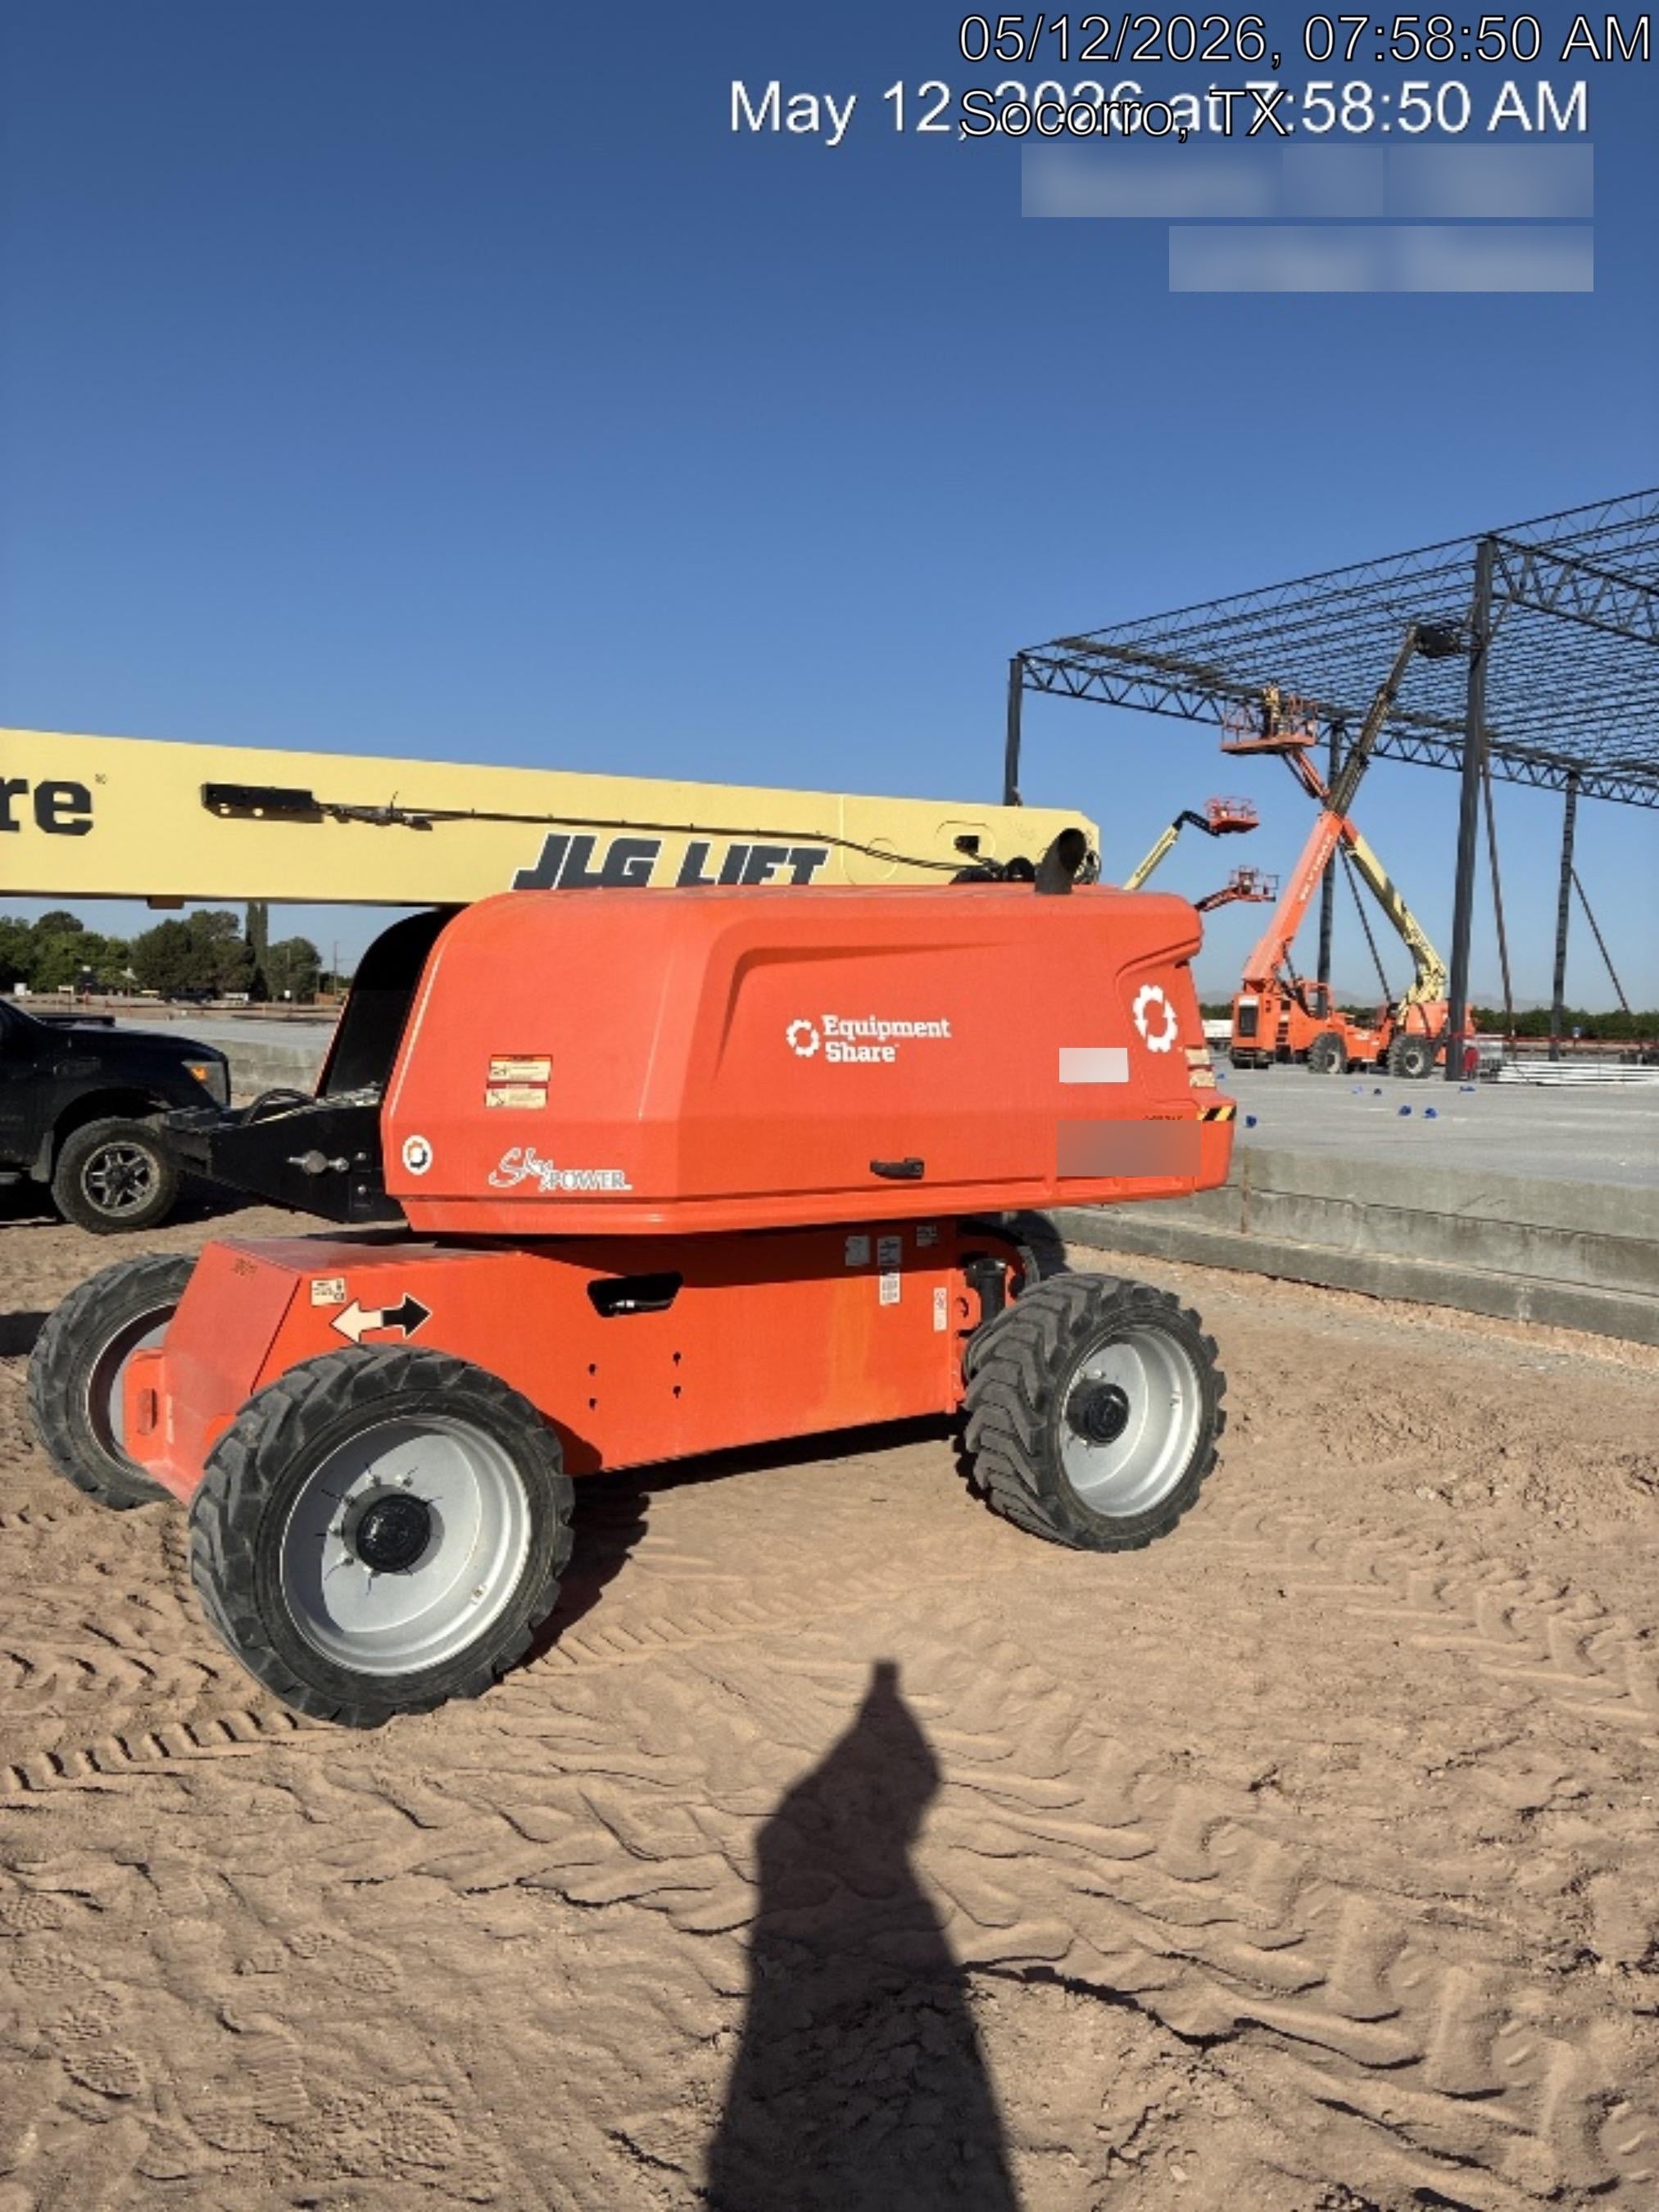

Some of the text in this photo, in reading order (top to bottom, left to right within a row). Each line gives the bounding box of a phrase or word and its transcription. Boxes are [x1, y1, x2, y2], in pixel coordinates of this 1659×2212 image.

[512, 833, 830, 891] JLG LIFT
[822, 1014, 952, 1041] Equipment
[824, 1040, 897, 1063] Share
